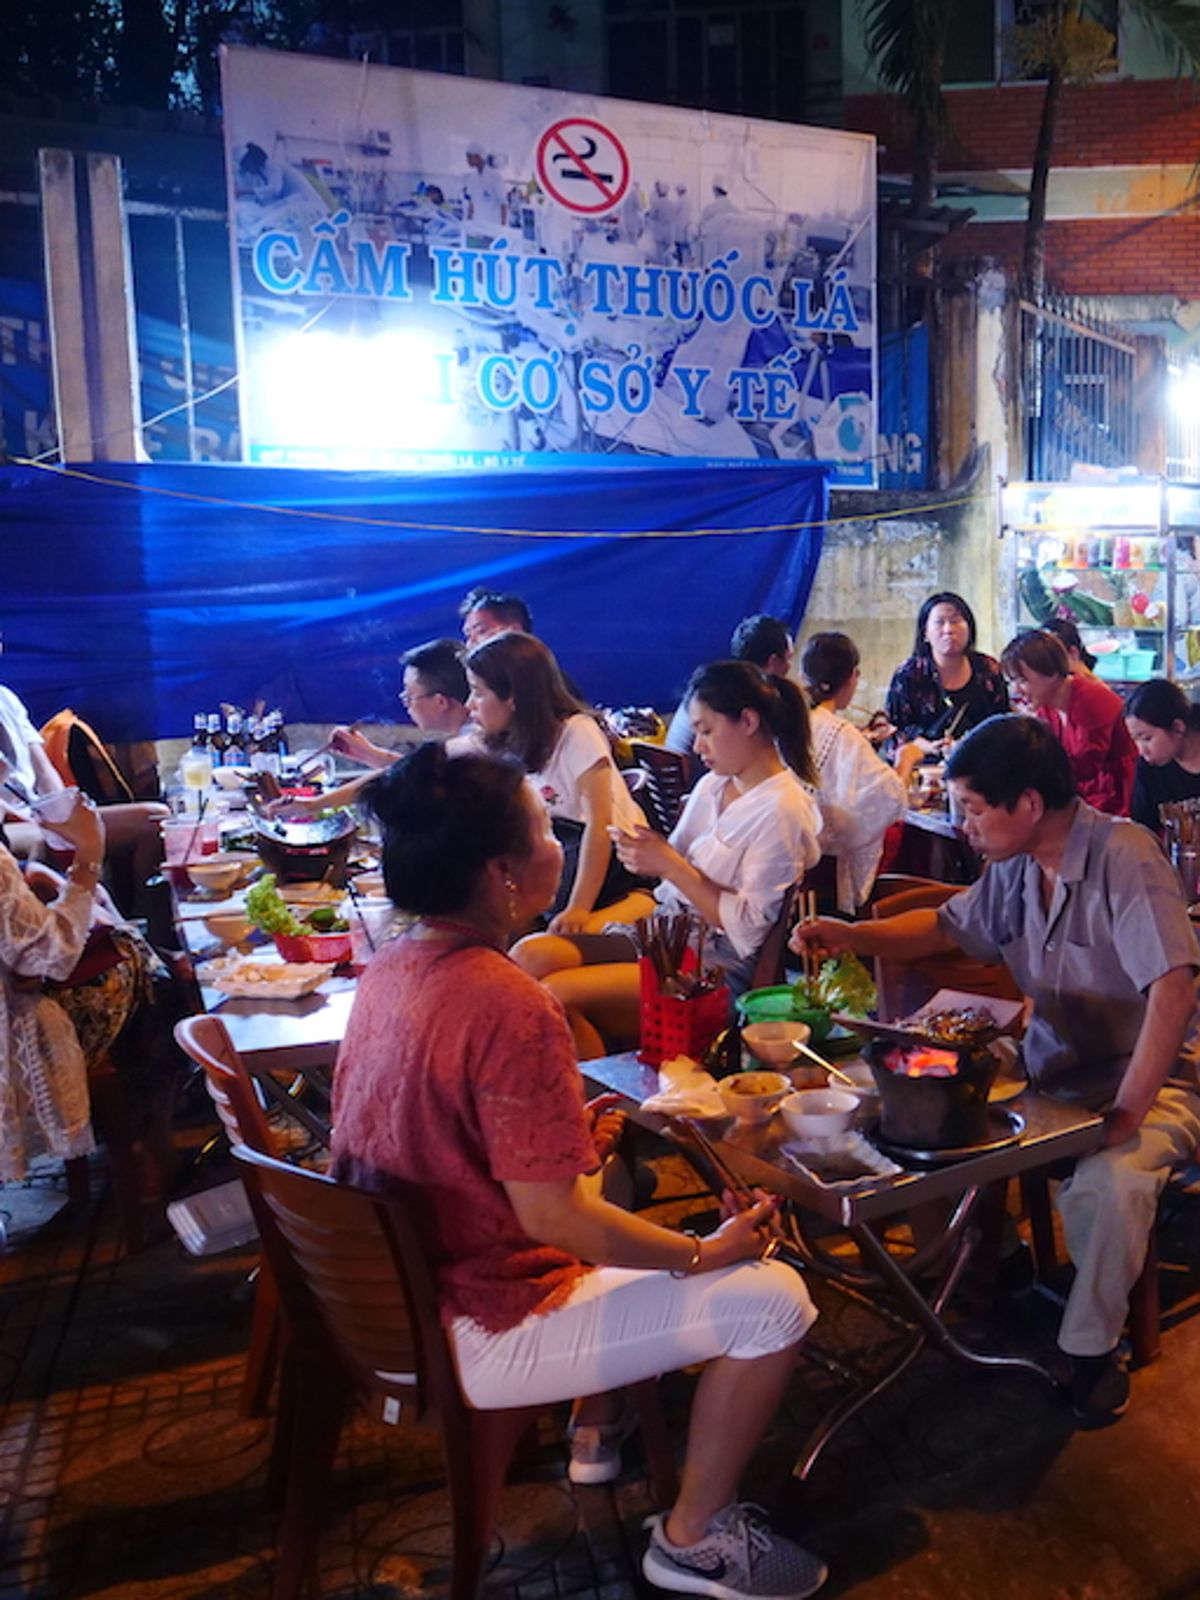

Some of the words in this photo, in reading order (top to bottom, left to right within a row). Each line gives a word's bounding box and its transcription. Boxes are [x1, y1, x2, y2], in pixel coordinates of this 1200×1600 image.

[253, 210, 411, 298] CẤM
[431, 238, 563, 310] HÚT
[584, 249, 776, 324] THUỐC
[791, 270, 860, 332] LÁ
[479, 350, 562, 411] CƠ
[580, 343, 655, 414] SỞ
[673, 367, 711, 417] Y
[728, 347, 801, 420] TẾ
